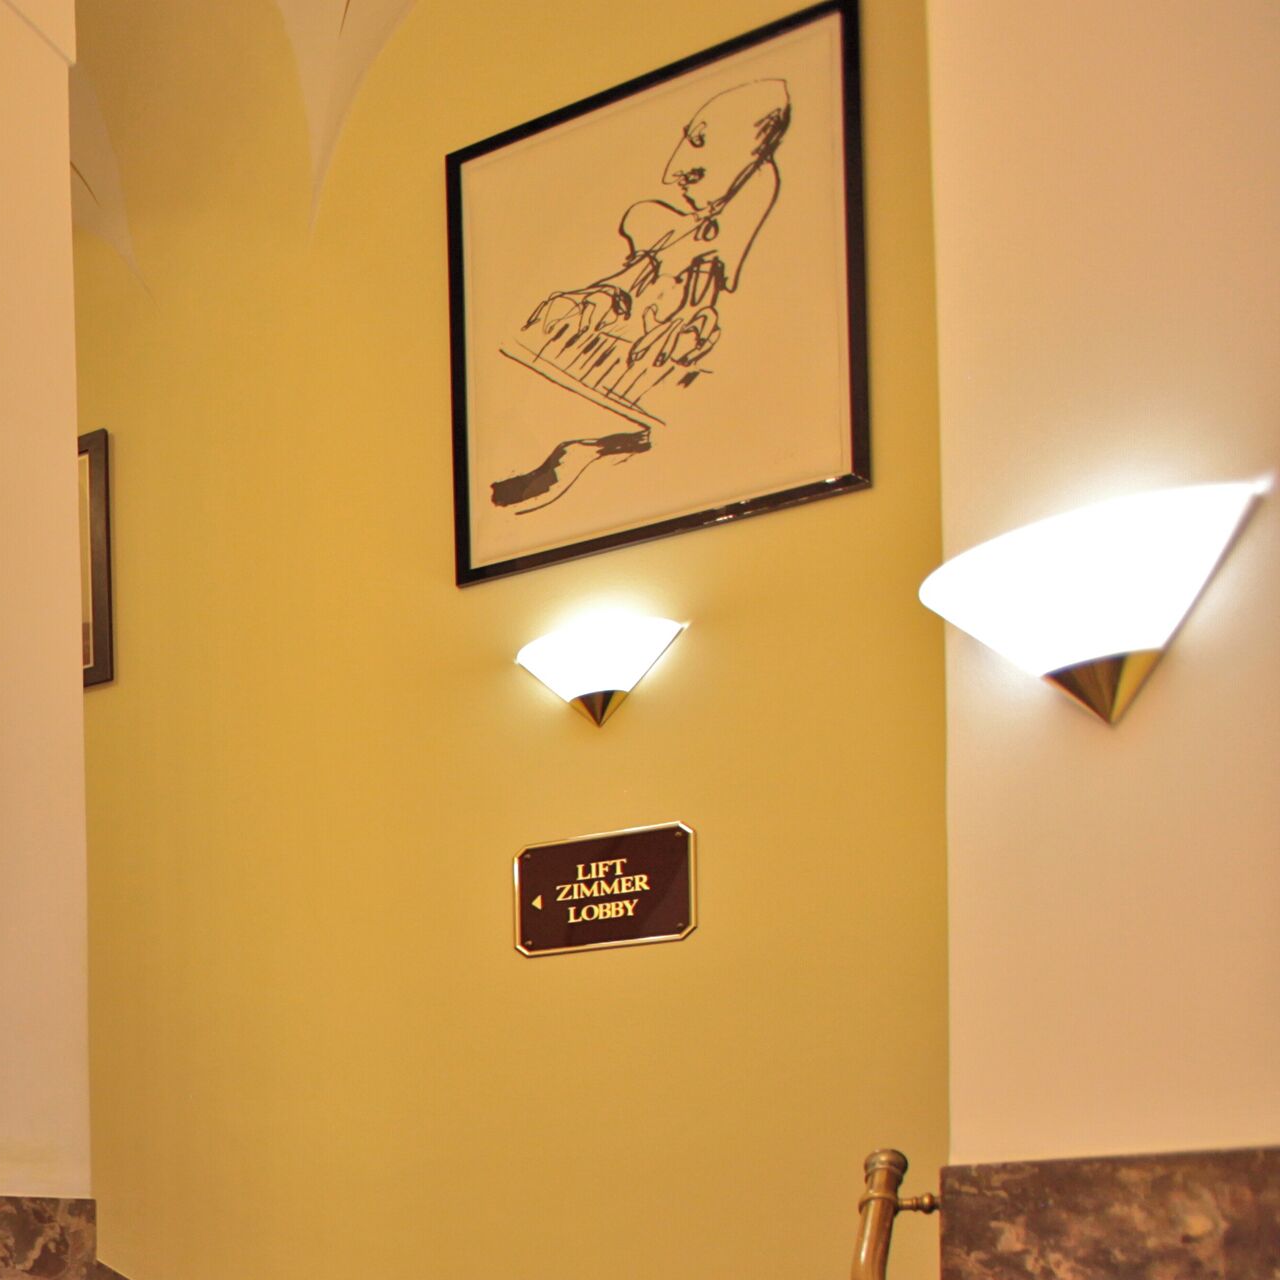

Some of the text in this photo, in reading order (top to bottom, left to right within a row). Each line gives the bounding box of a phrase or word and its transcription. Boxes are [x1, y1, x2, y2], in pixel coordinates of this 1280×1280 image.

[576, 858, 627, 881] LIFT
[556, 874, 650, 901] ZIMMER
[567, 899, 639, 923] LOBBY
